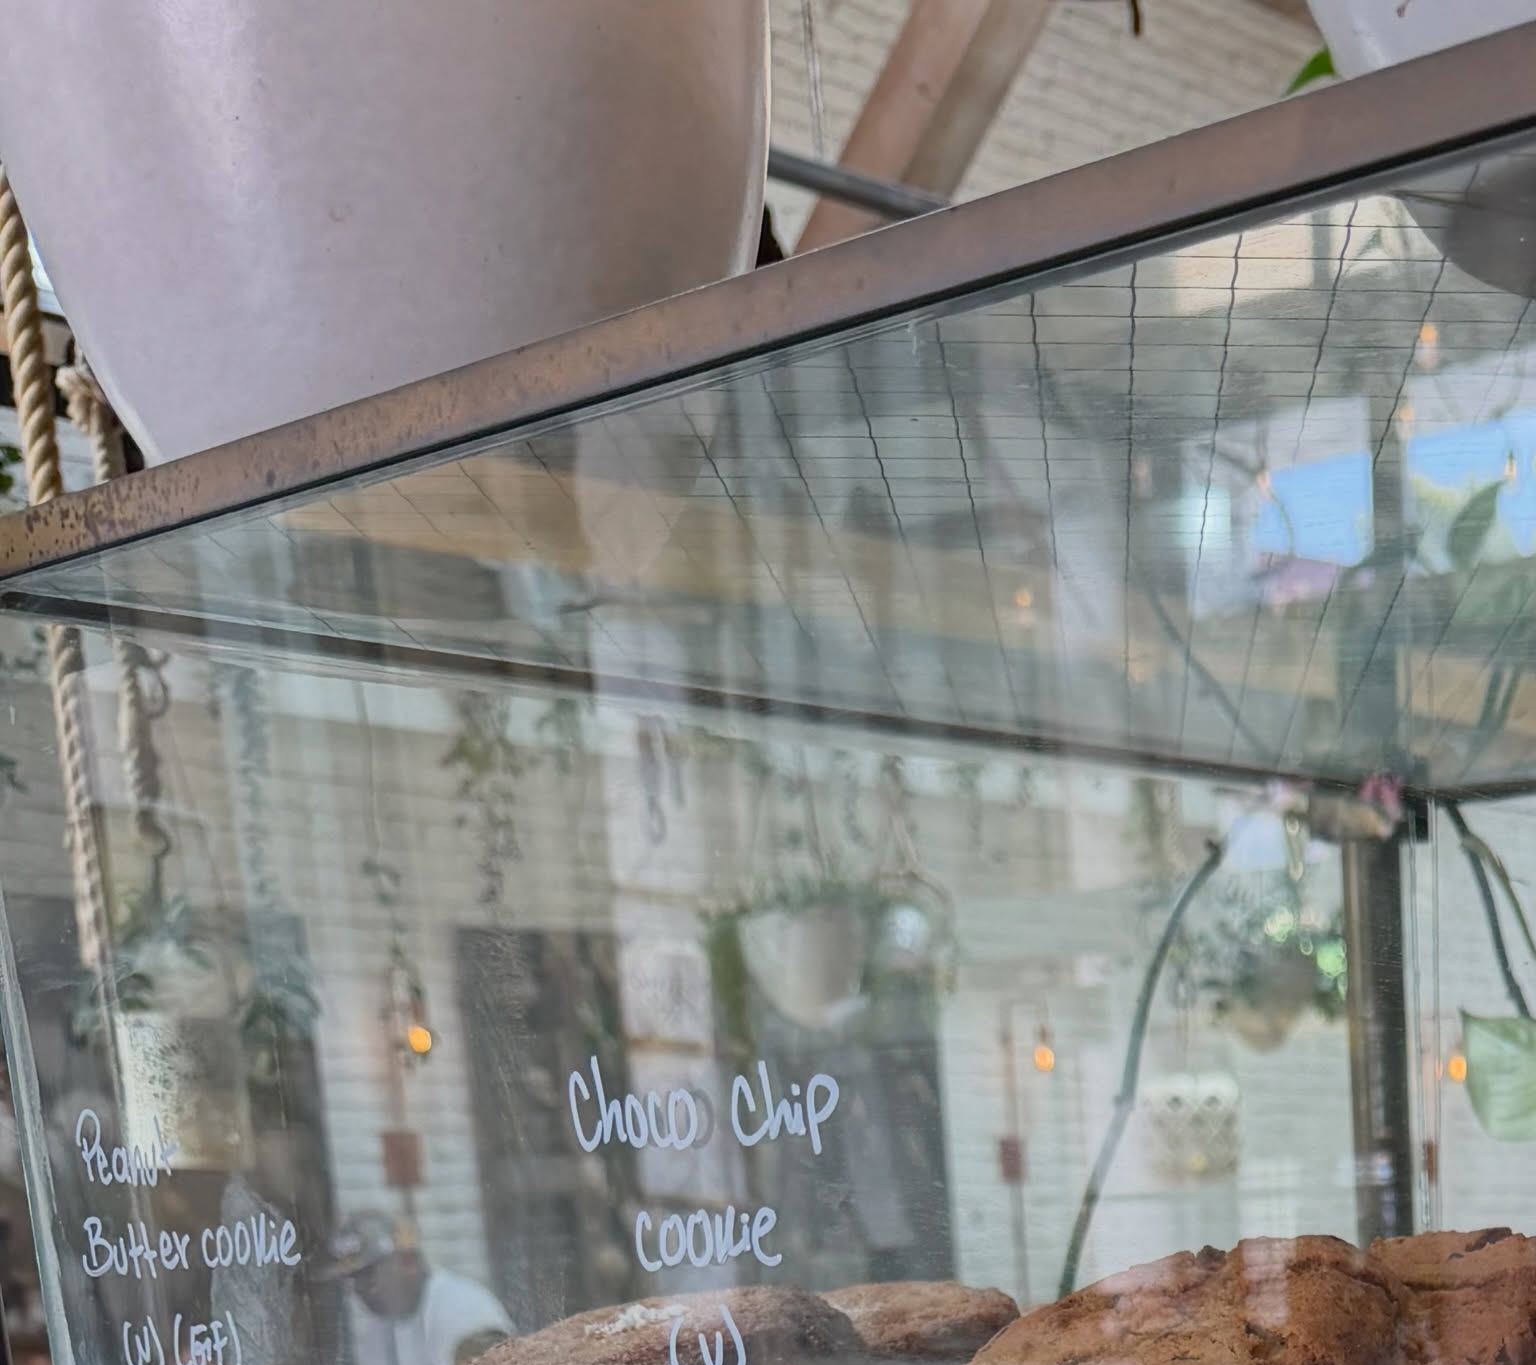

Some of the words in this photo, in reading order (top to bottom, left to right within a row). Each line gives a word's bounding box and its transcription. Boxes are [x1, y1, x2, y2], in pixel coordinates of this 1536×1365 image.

[569, 1055, 698, 1152] Choco
[76, 1109, 180, 1188] Peanut
[82, 1216, 191, 1279] Butter
